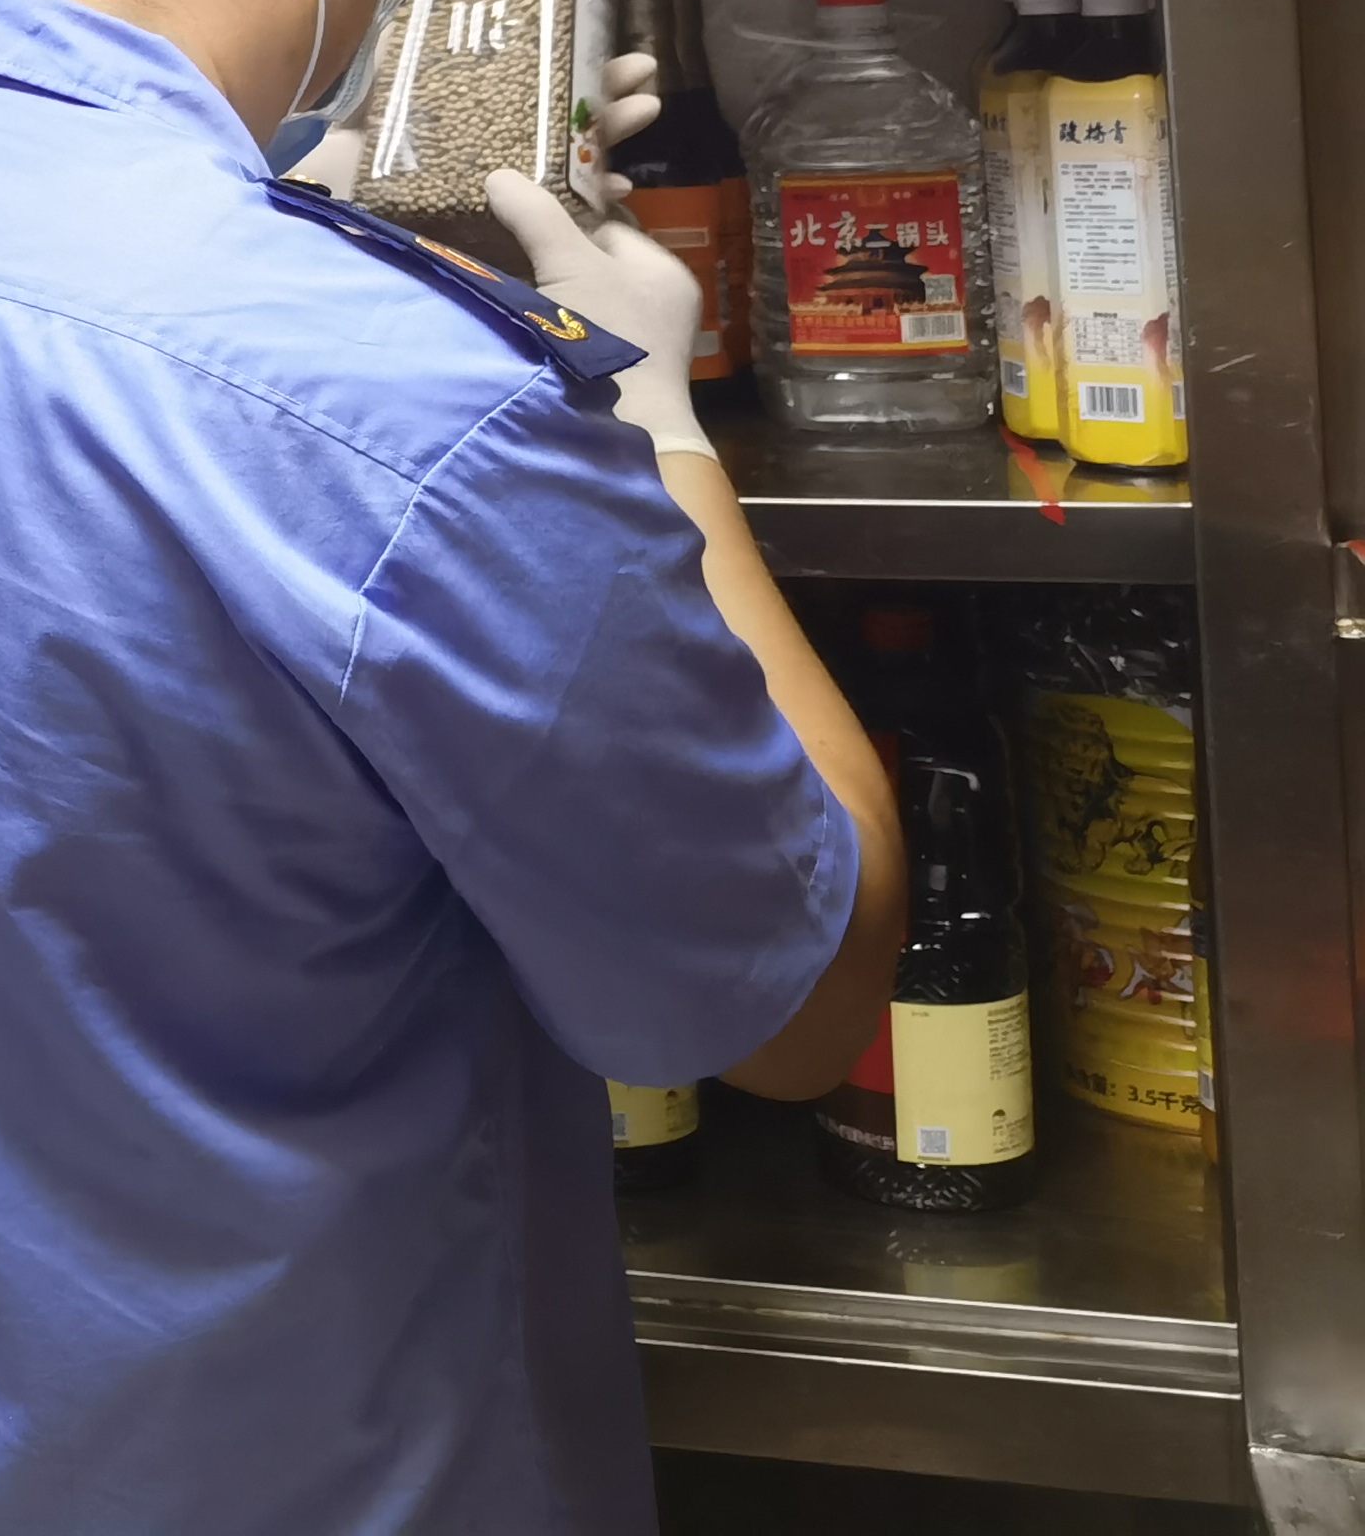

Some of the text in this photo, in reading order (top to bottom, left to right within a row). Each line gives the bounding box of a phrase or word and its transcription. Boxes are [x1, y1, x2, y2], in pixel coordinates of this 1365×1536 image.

[789, 210, 950, 253] 北京二锅头
